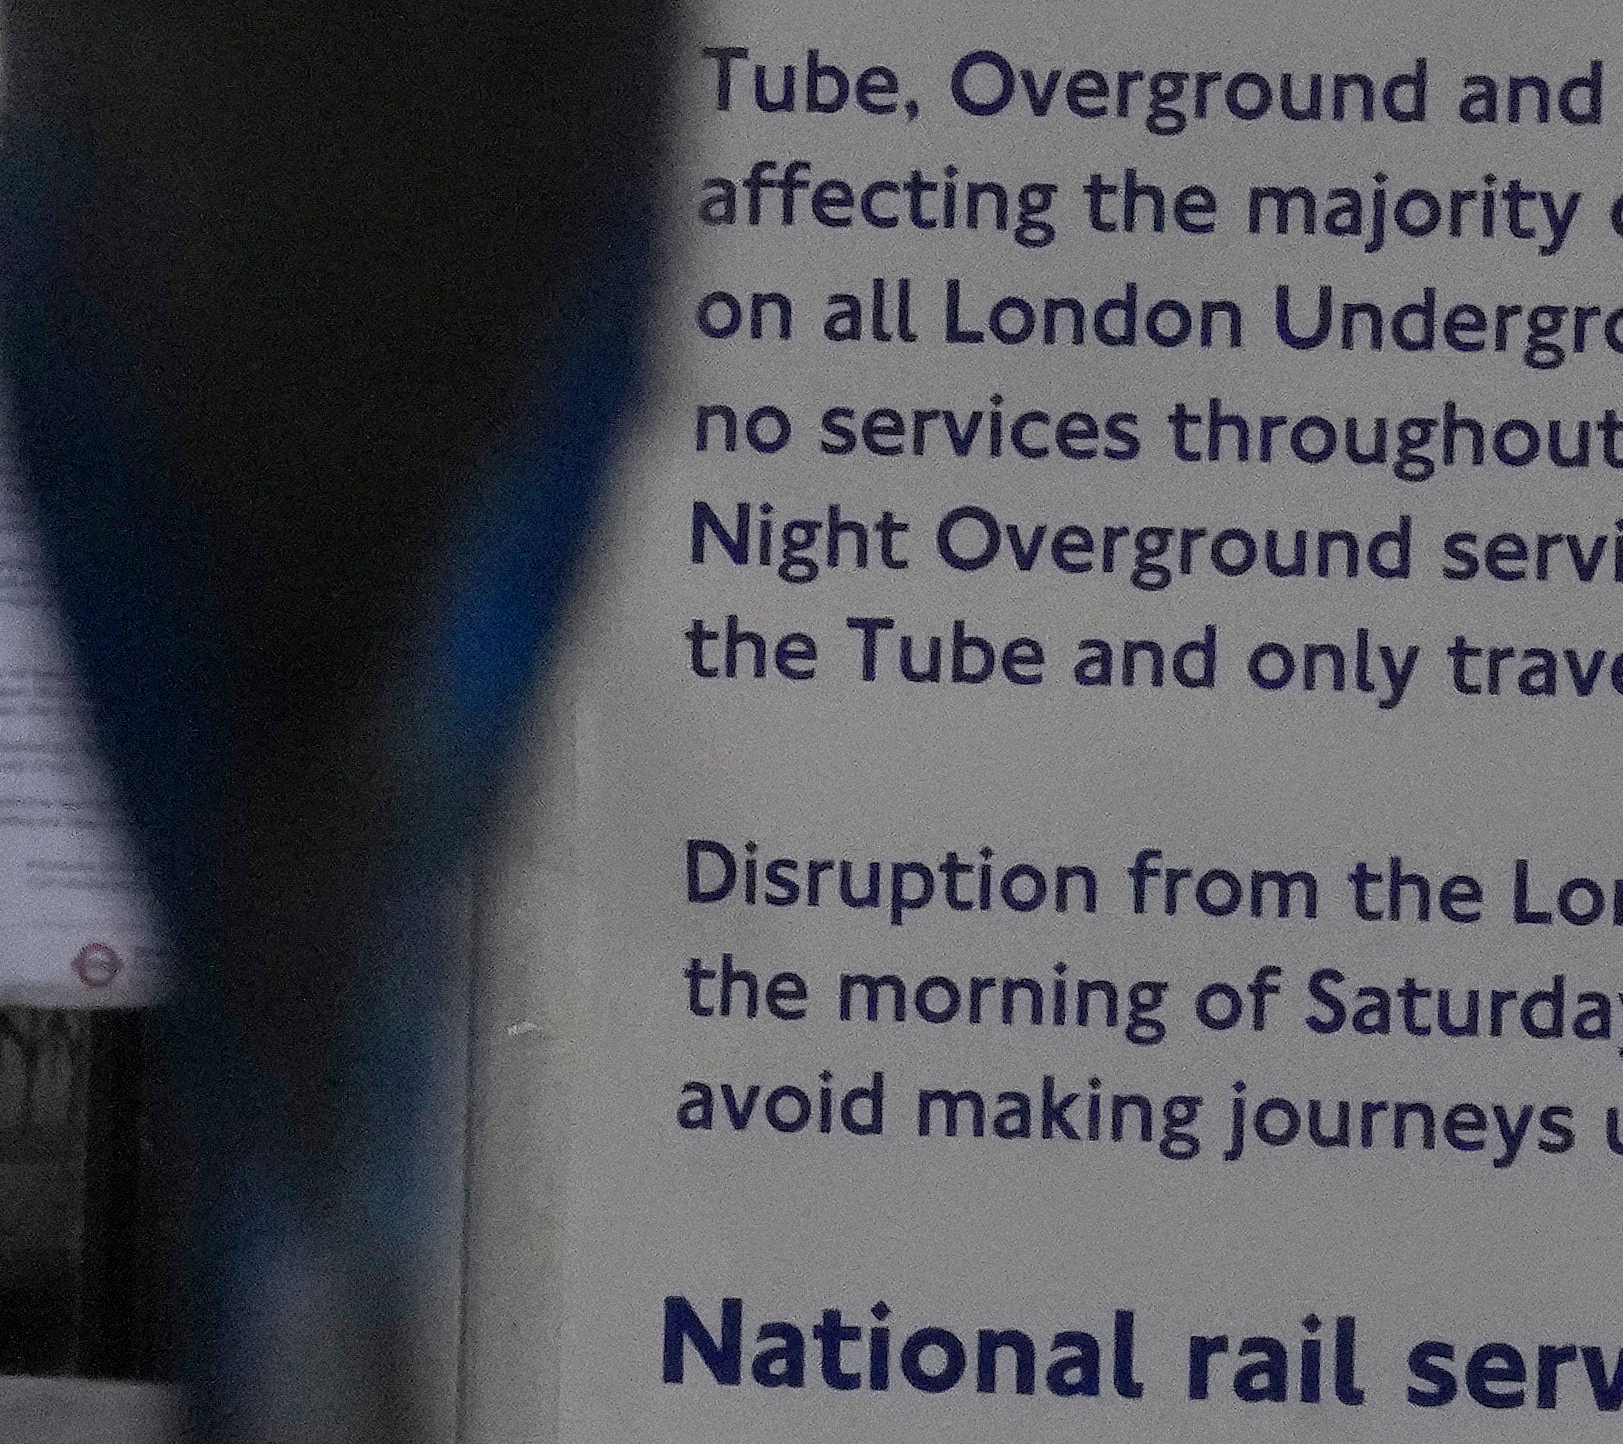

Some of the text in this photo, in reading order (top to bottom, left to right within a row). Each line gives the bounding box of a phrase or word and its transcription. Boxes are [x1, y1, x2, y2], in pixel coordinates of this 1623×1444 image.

[702, 47, 919, 120] Tube,
[950, 49, 1428, 136] Overground
[1458, 59, 1603, 126] and
[699, 159, 1058, 248] affecting
[1083, 168, 1218, 235] the
[1248, 172, 1582, 256] majority
[696, 291, 793, 340] on
[823, 277, 917, 343] all
[945, 278, 1243, 348] London
[696, 405, 792, 454] no
[820, 393, 1141, 461] services
[691, 500, 909, 585] Night
[936, 505, 1412, 592] Overground
[684, 614, 818, 681] the
[846, 616, 1045, 686] Tube
[1073, 624, 1217, 689] and
[1247, 627, 1420, 710] only
[686, 839, 1098, 926] Disruption
[1128, 848, 1318, 919] from
[1348, 856, 1483, 924] the
[684, 953, 808, 1021] the
[839, 962, 1169, 1046] morning
[1195, 965, 1282, 1031] of
[677, 1070, 885, 1136] avoid
[918, 1075, 1203, 1161] making
[1223, 1080, 1575, 1169] journeys
[662, 1295, 1144, 1400] National
[1188, 1313, 1365, 1407] rail
